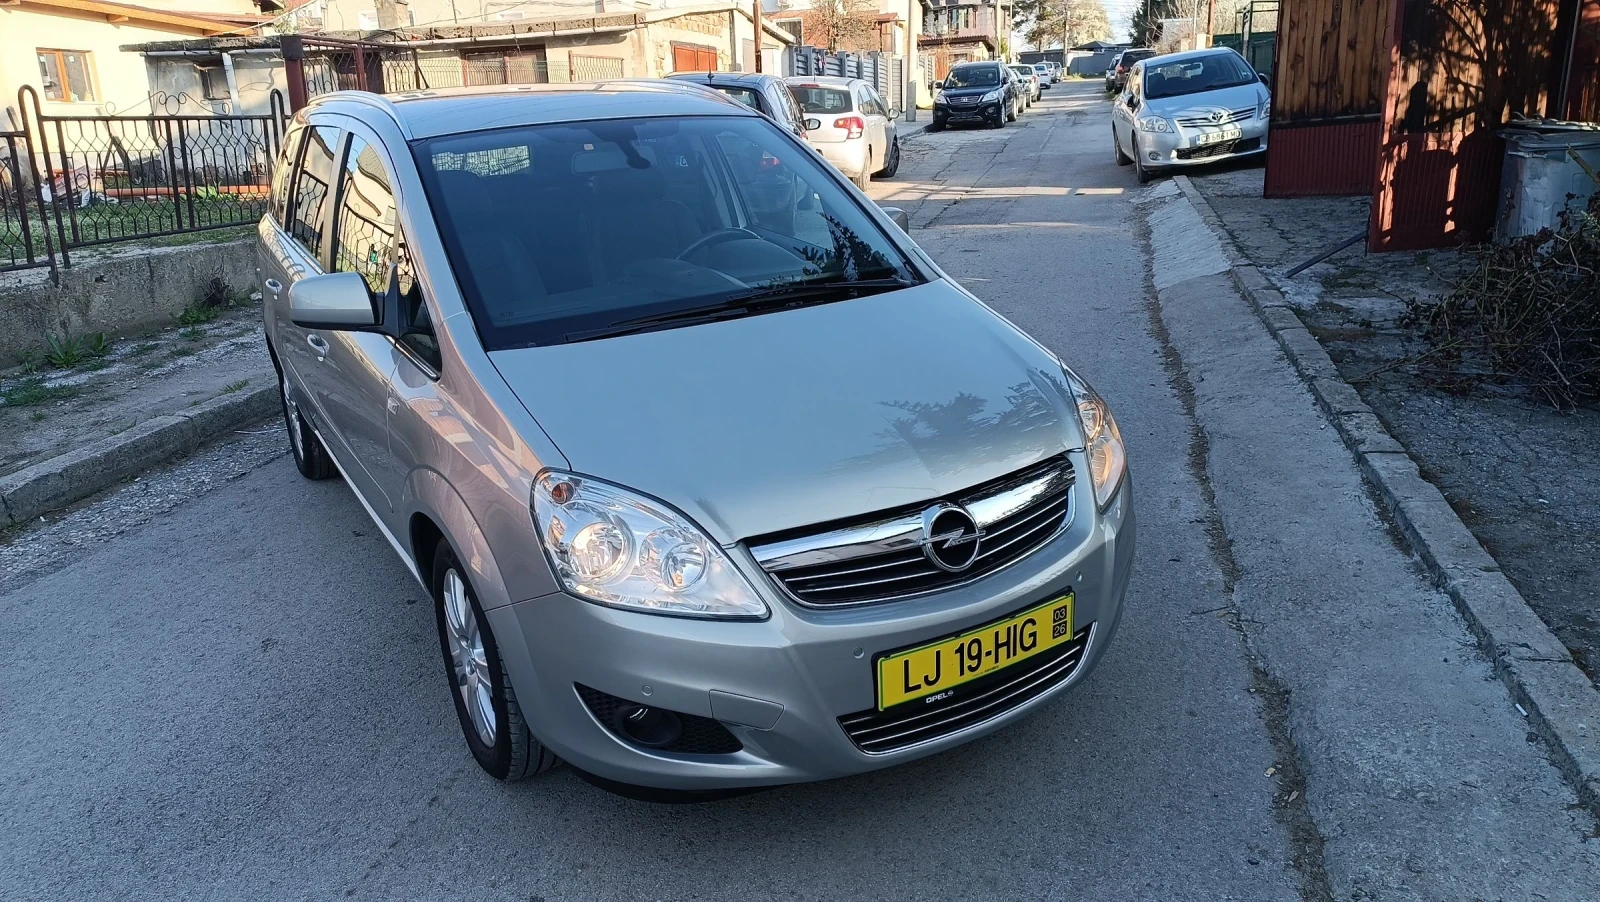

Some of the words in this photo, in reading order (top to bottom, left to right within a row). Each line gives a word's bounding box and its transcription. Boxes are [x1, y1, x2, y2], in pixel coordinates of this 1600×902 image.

[1054, 608, 1066, 621] 03
[1053, 623, 1066, 637] 26
[903, 649, 941, 694] LJ
[954, 617, 1037, 678] 19-HIG
[925, 692, 948, 704] OPEL
